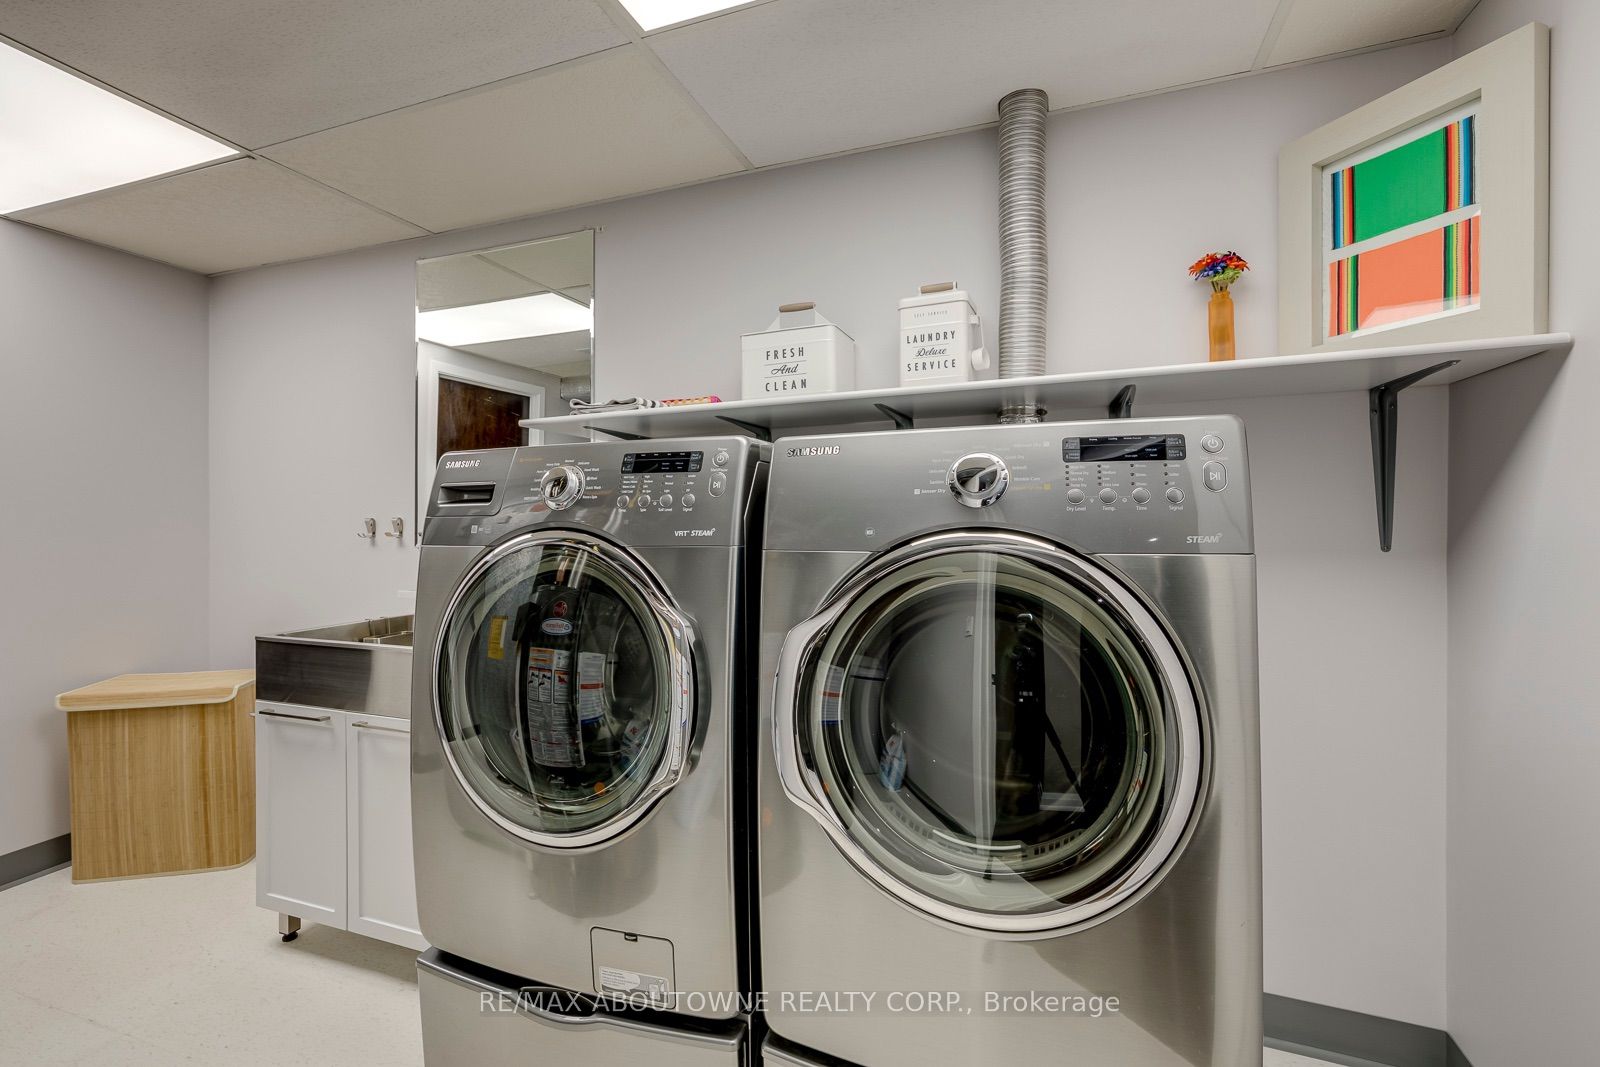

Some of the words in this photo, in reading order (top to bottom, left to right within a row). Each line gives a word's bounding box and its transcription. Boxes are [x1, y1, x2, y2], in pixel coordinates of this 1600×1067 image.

[906, 330, 956, 344] LAUNDRY
[766, 347, 805, 361] FRESH
[915, 347, 947, 357] Deluxe
[771, 363, 799, 375] And
[907, 359, 956, 372] SERVICE
[765, 378, 807, 392] CLEAN
[786, 445, 840, 457] SAMSUNG
[445, 459, 481, 469] SAMSUNG
[690, 529, 714, 537] STEAM
[1186, 535, 1220, 544] STEAM
